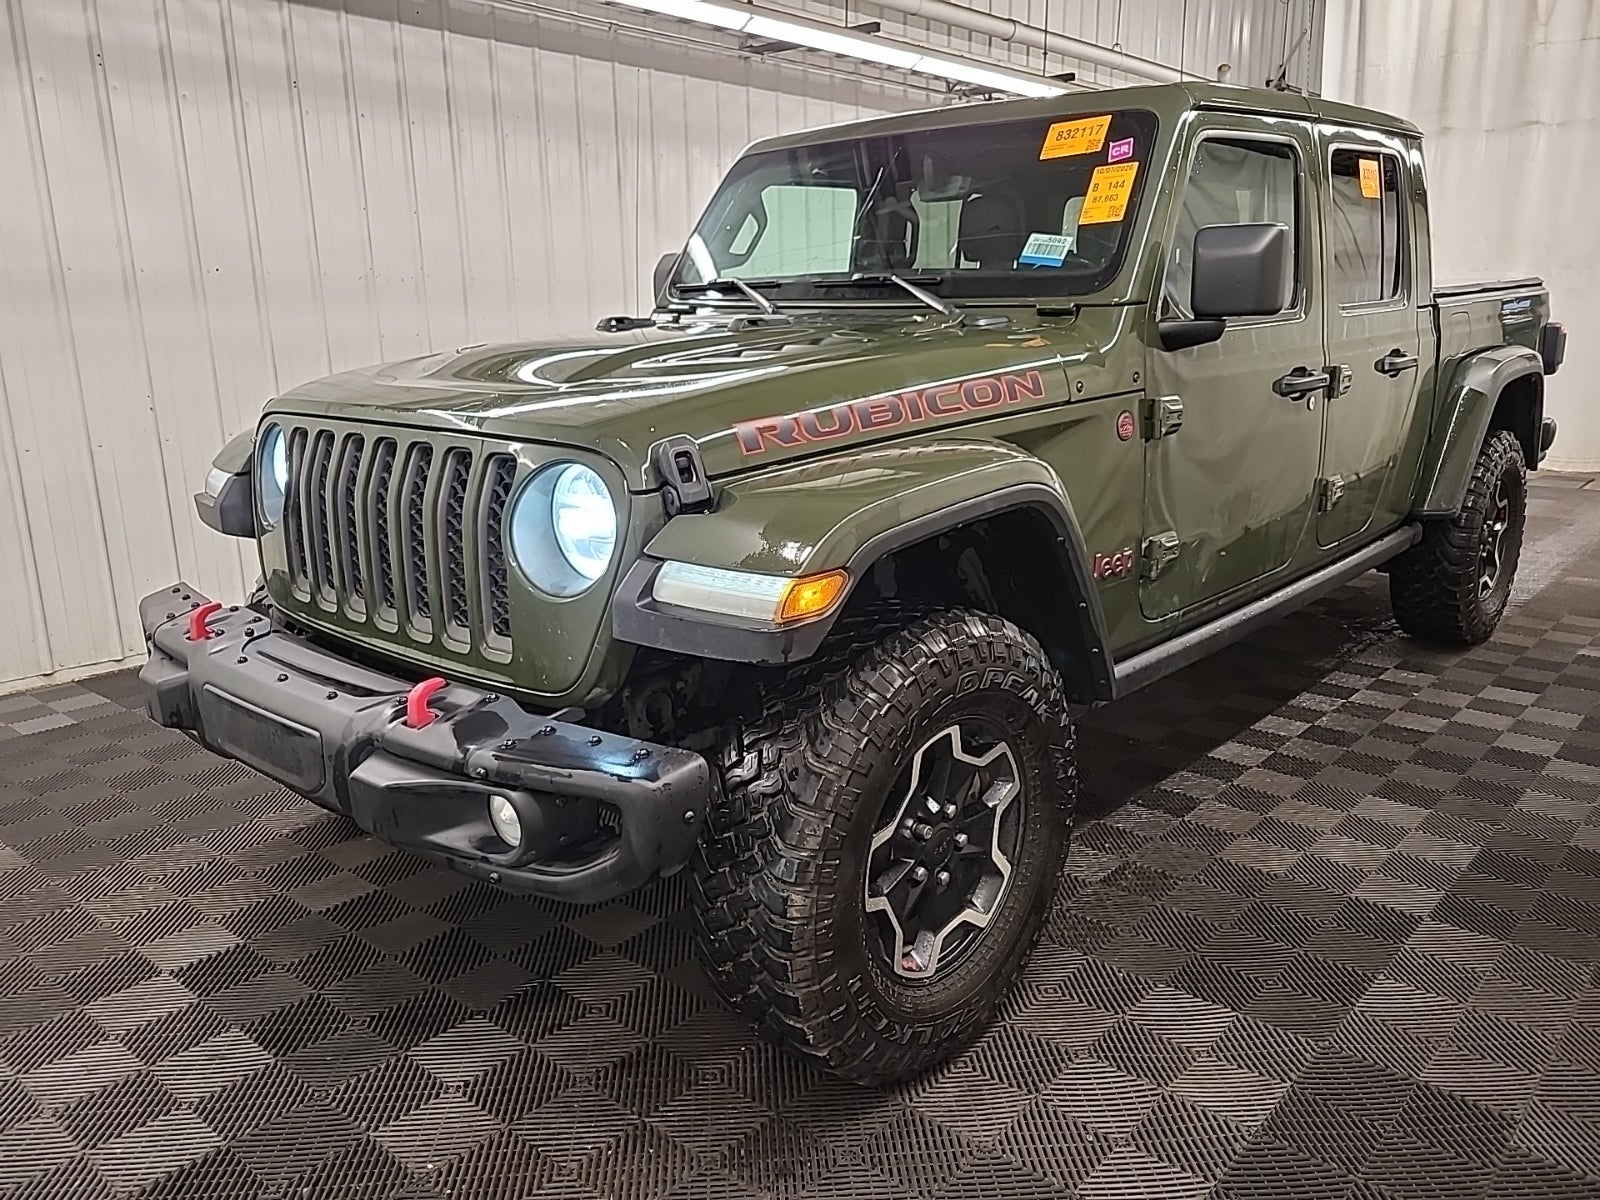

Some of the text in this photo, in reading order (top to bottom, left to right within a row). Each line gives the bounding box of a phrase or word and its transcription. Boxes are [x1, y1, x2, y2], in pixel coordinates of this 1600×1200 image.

[1056, 124, 1104, 141] 832117
[1112, 144, 1129, 156] CR
[1092, 180, 1125, 192] B 144
[733, 370, 1045, 456] RUBICON
[1093, 547, 1133, 579] Jeep
